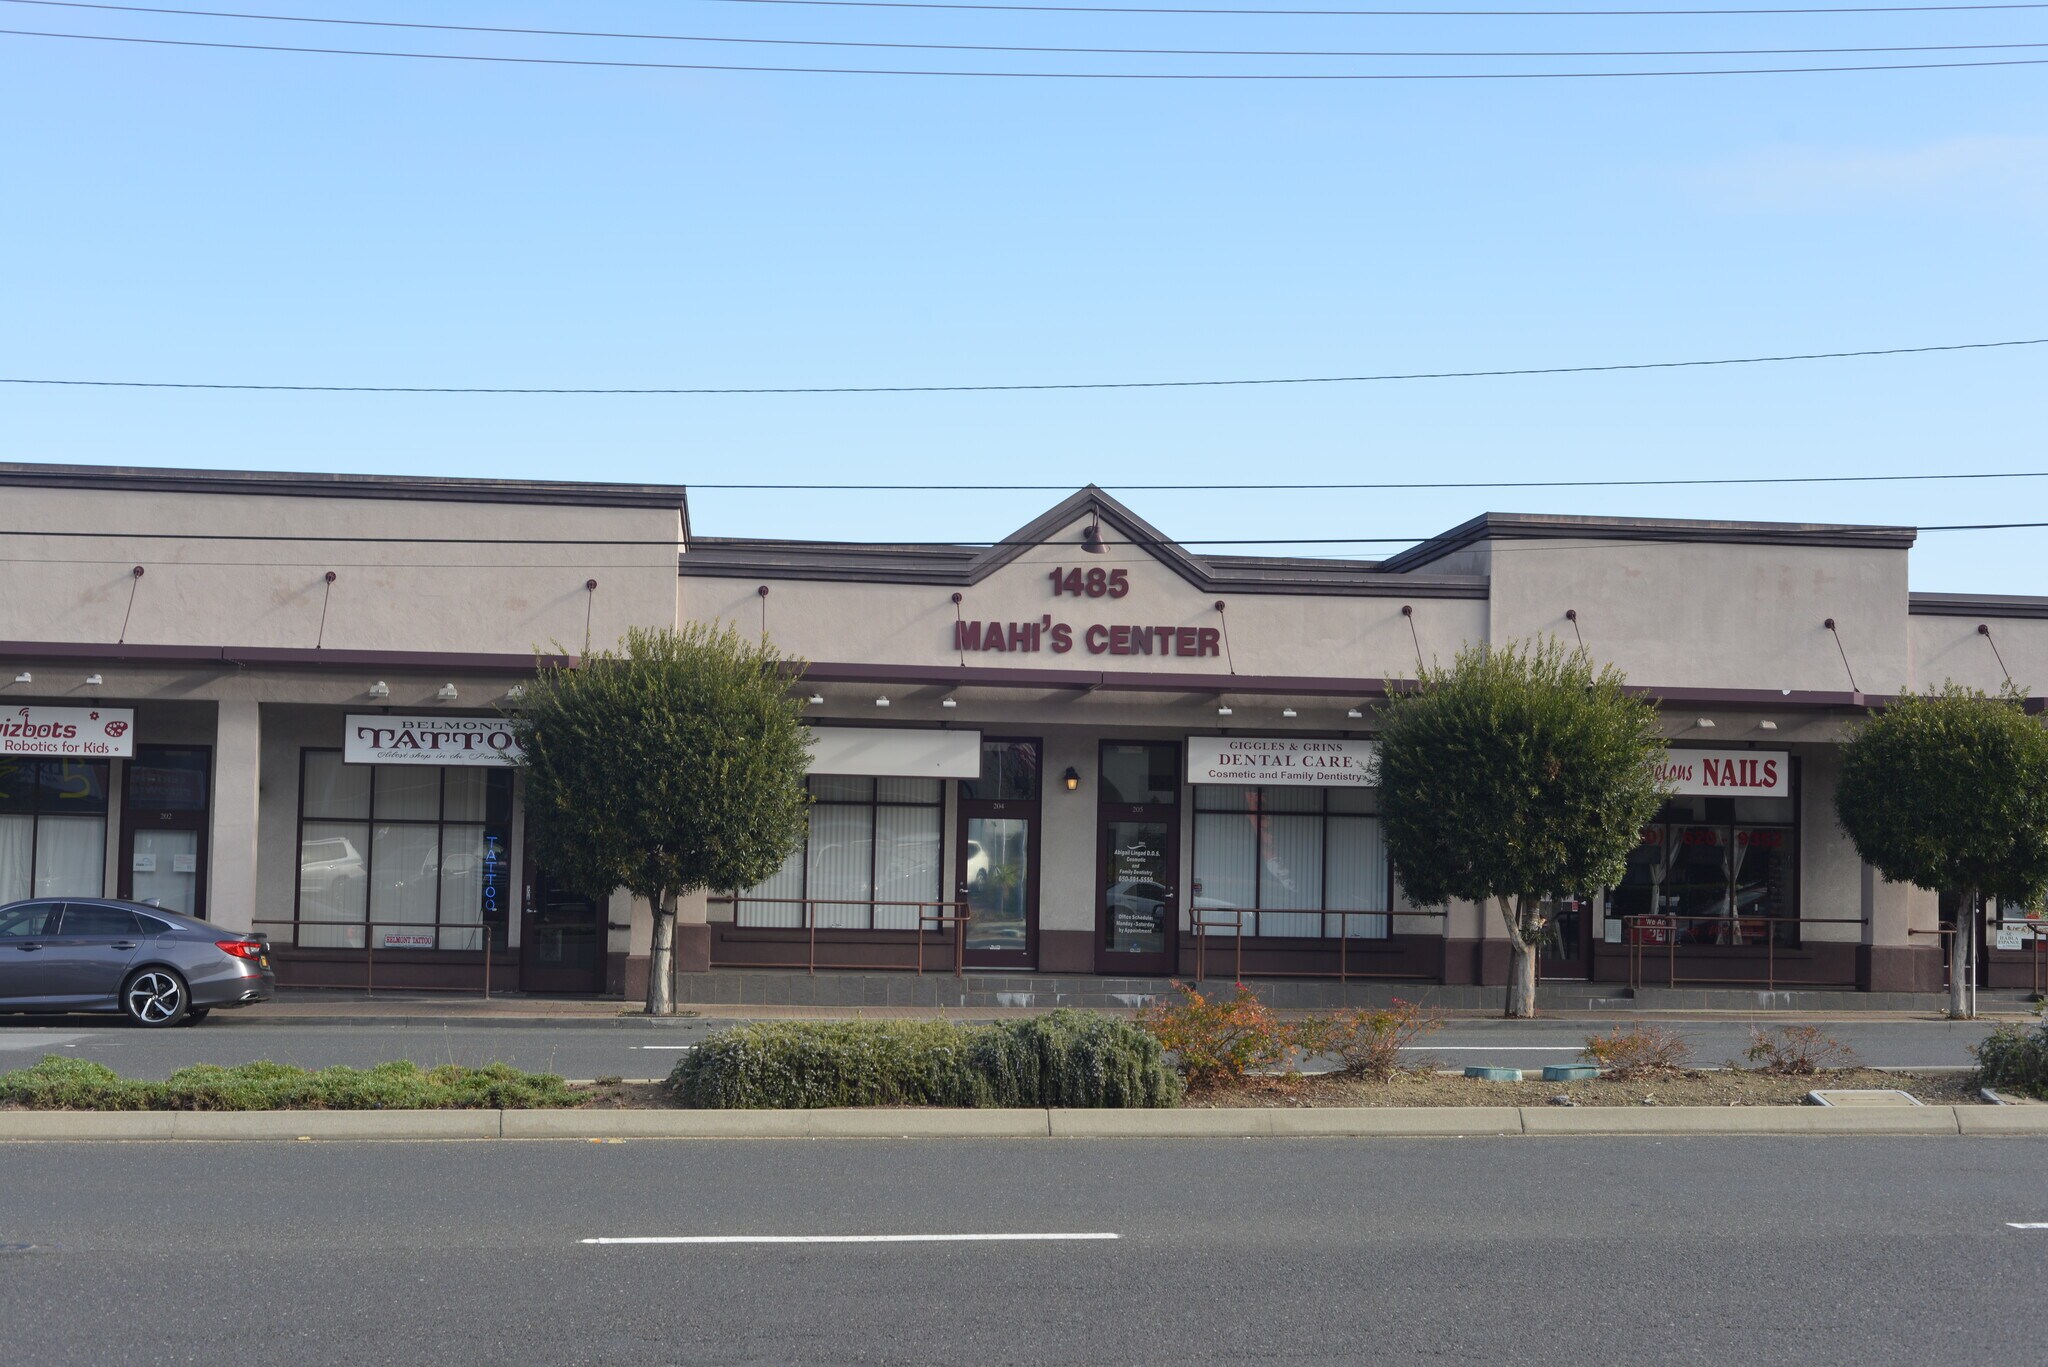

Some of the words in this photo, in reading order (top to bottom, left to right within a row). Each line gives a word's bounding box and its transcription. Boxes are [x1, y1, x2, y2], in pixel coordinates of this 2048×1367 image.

[1048, 566, 1130, 599] 1485
[955, 614, 1073, 653] MAHI'S
[1085, 623, 1221, 657] CENTER
[0, 716, 77, 738] izbots
[401, 721, 508, 730] BELMONT
[4, 740, 58, 752] Robotics
[62, 741, 80, 752] for
[84, 742, 110, 754] Kids
[1229, 741, 1285, 751] GIGGLES
[1289, 743, 1298, 751] &
[1303, 743, 1343, 752] GRINS
[409, 752, 432, 760] shop
[1219, 753, 1296, 767] DENTAL
[1302, 755, 1354, 768] CARE
[1208, 769, 1257, 779] Cosmetic
[1259, 771, 1278, 780] and
[1280, 771, 1314, 782] Family
[1316, 772, 1362, 782] Dentistry
[1702, 758, 1778, 788] NAILS
[992, 802, 1005, 810] 204
[160, 812, 173, 820] 202
[1683, 831, 1717, 846] 620
[485, 836, 498, 911] TATTOO
